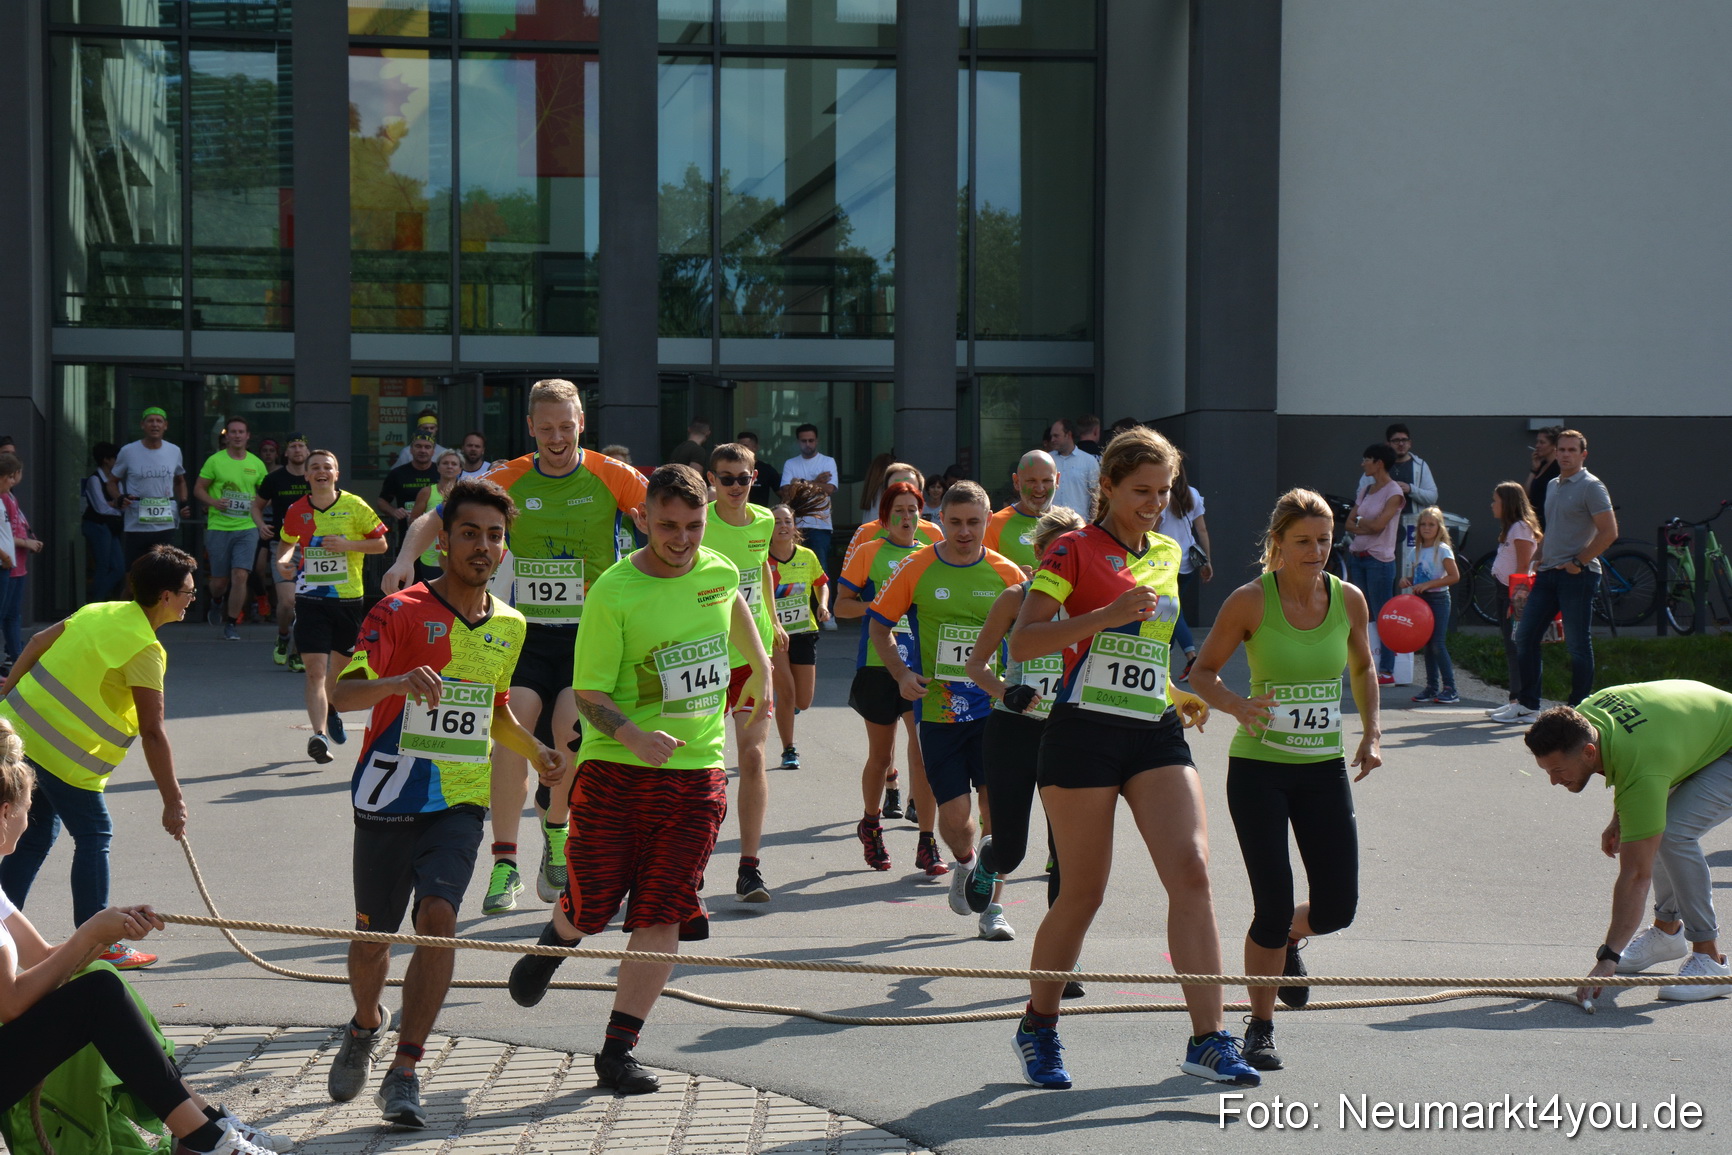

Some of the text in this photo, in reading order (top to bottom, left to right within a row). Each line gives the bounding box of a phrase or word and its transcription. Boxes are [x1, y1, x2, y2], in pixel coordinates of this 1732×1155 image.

[379, 407, 407, 416] REWE
[384, 430, 403, 441] dm
[229, 500, 245, 510] 134
[567, 496, 593, 506] BOCK
[146, 507, 165, 516] 107
[313, 560, 338, 573] 162
[518, 560, 577, 577] BOCK
[527, 581, 567, 601] 192
[776, 597, 803, 608] OCK
[777, 609, 800, 623] 157
[661, 637, 723, 668] BOCK
[1097, 635, 1164, 664] BOCK
[680, 664, 720, 693] 144
[1107, 662, 1156, 692] 180
[440, 684, 489, 705] OCK
[1039, 677, 1061, 696] 14
[1272, 683, 1338, 702] BOCK
[686, 694, 719, 710] CHRIS
[426, 708, 476, 735] 168
[1288, 707, 1330, 729] 143
[1593, 692, 1648, 735] TEAM
[411, 736, 446, 749] BASHIR
[1285, 735, 1324, 746] SONJA
[367, 758, 399, 805] 7
